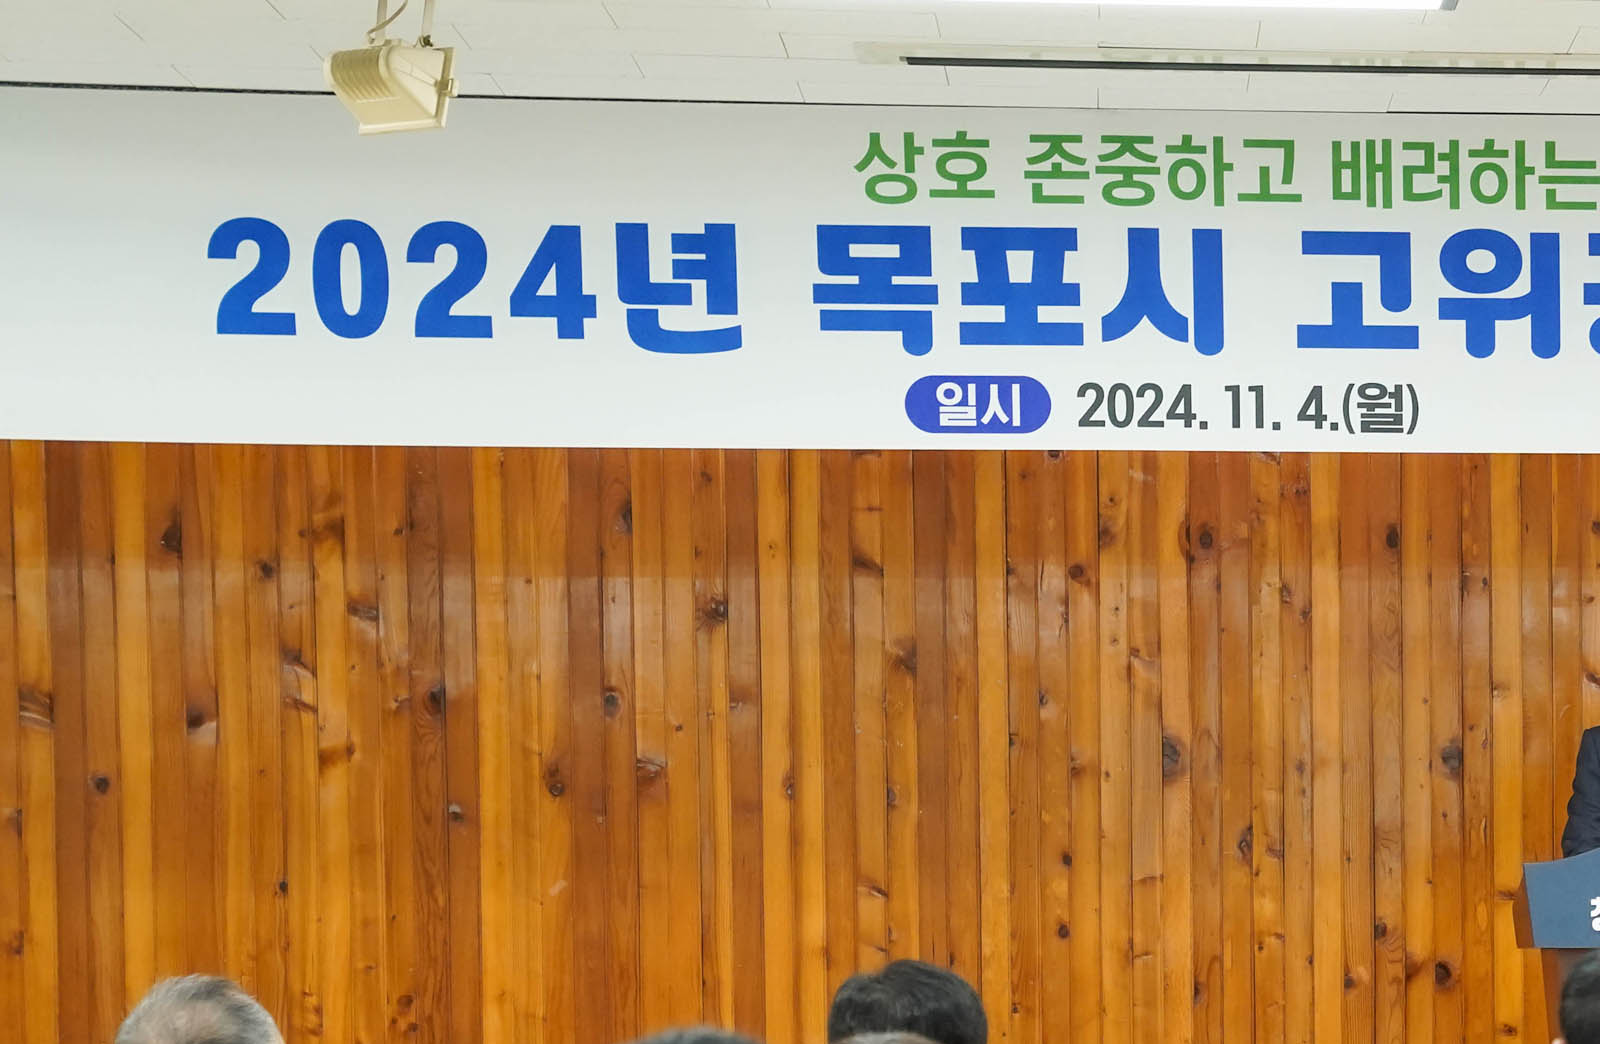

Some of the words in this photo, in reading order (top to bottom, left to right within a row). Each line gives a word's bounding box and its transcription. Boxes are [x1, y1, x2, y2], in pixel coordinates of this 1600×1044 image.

[854, 131, 995, 204] 상호
[1023, 134, 1302, 207] 존중하고
[207, 216, 743, 354] 2024년
[812, 224, 1225, 356] 목포시
[935, 382, 1021, 427] 일시
[1077, 382, 1209, 430] 2024.
[1225, 384, 1281, 431] 11.
